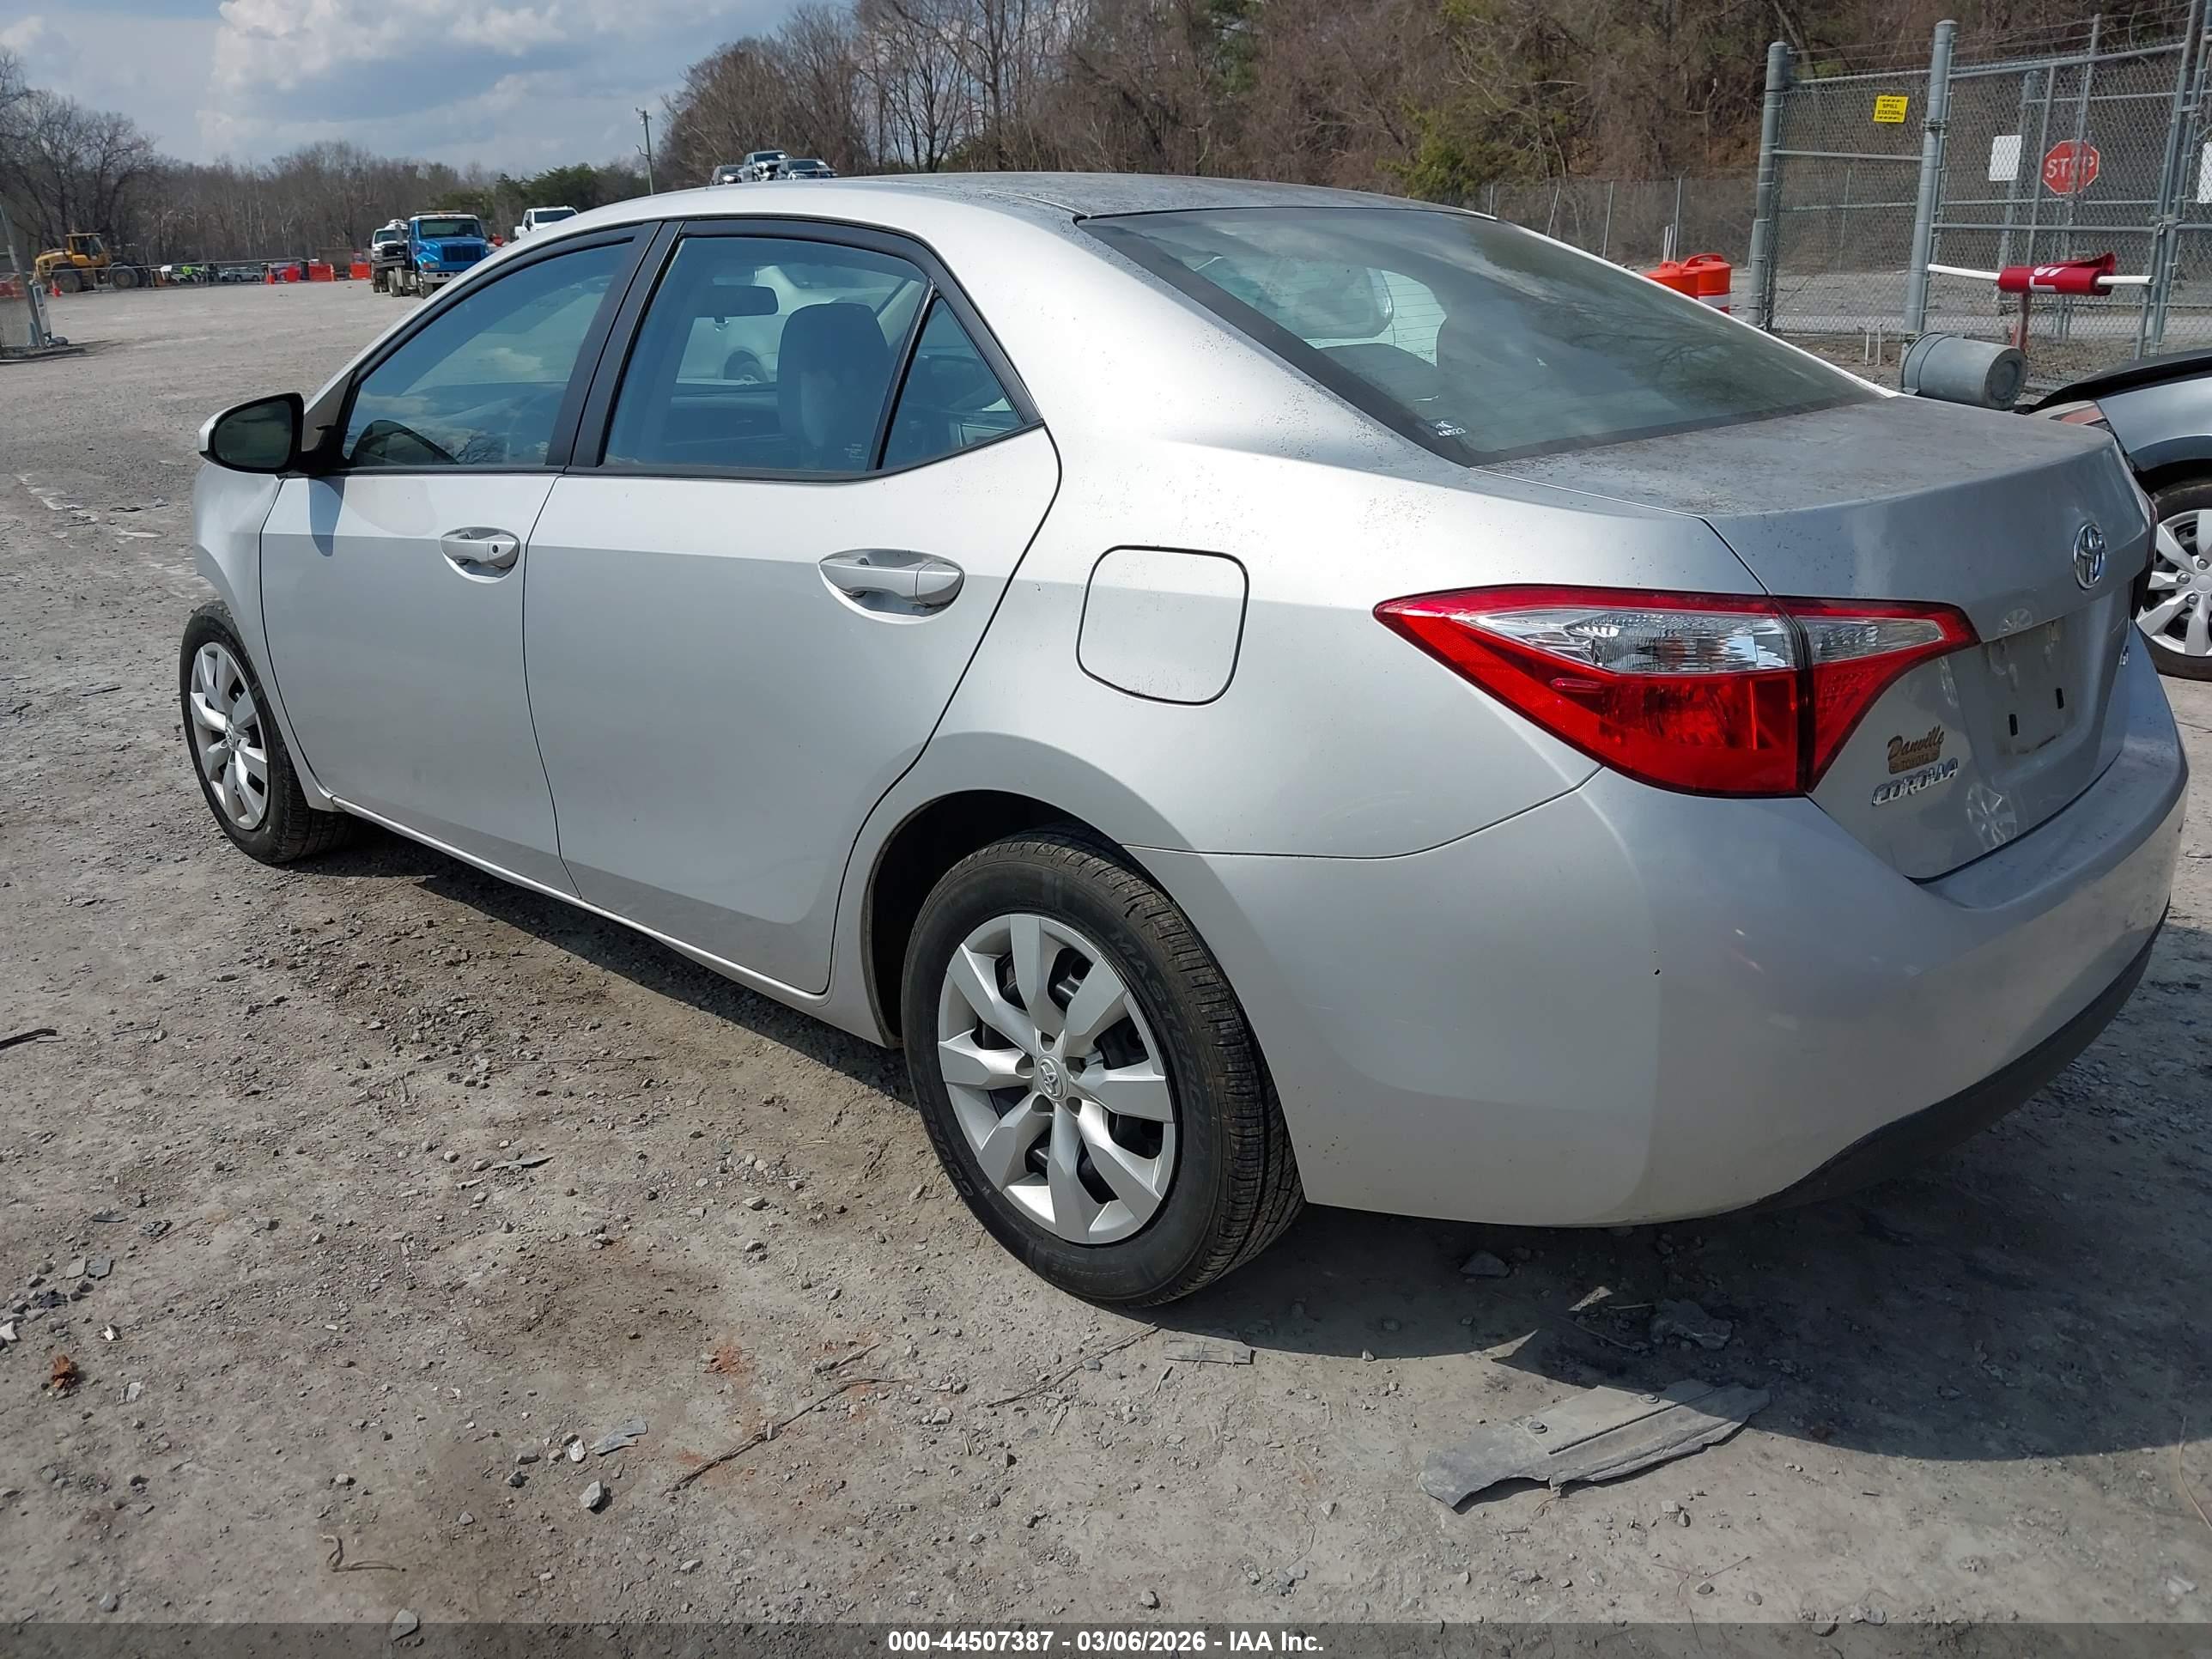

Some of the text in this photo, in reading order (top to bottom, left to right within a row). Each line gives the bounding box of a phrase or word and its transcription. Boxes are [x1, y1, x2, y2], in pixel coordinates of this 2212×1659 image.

[2046, 156, 2095, 179] STOP
[1887, 725, 1945, 763] Danville
[1872, 757, 1959, 805] COROLLA
